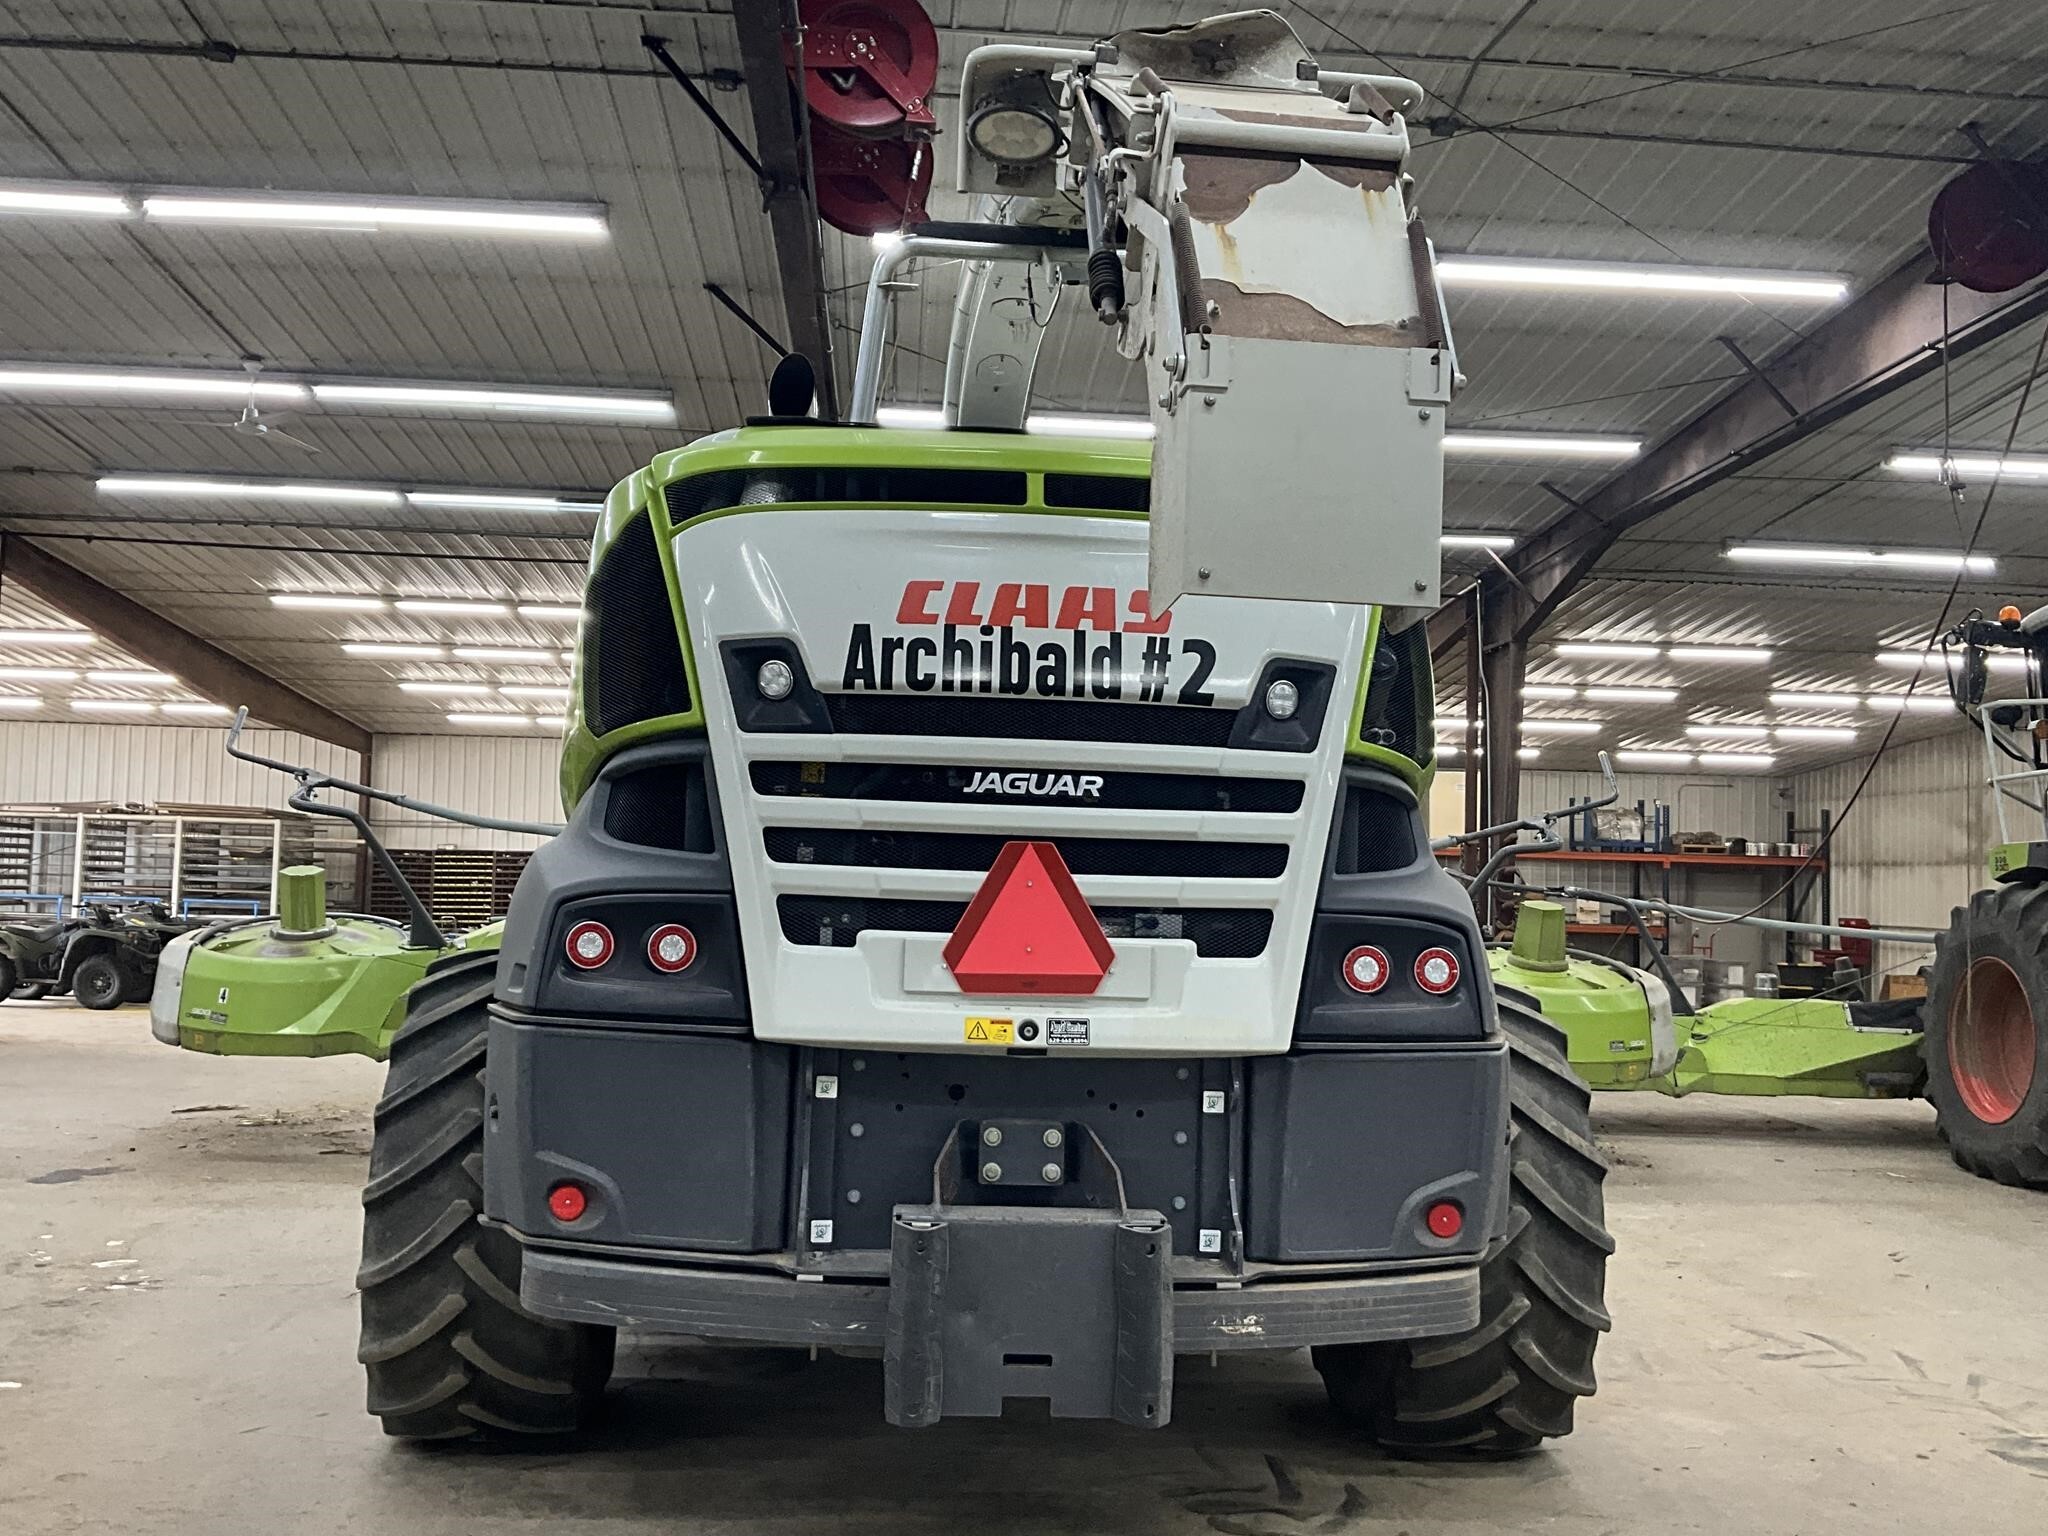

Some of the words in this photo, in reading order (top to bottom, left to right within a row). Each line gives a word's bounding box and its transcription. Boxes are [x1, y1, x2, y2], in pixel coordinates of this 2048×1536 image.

[896, 580, 1173, 634] CLAAS
[842, 623, 1122, 700] Archibald
[1138, 635, 1217, 707] #2
[963, 771, 1104, 798] JAGUAR
[220, 988, 227, 1003] 4
